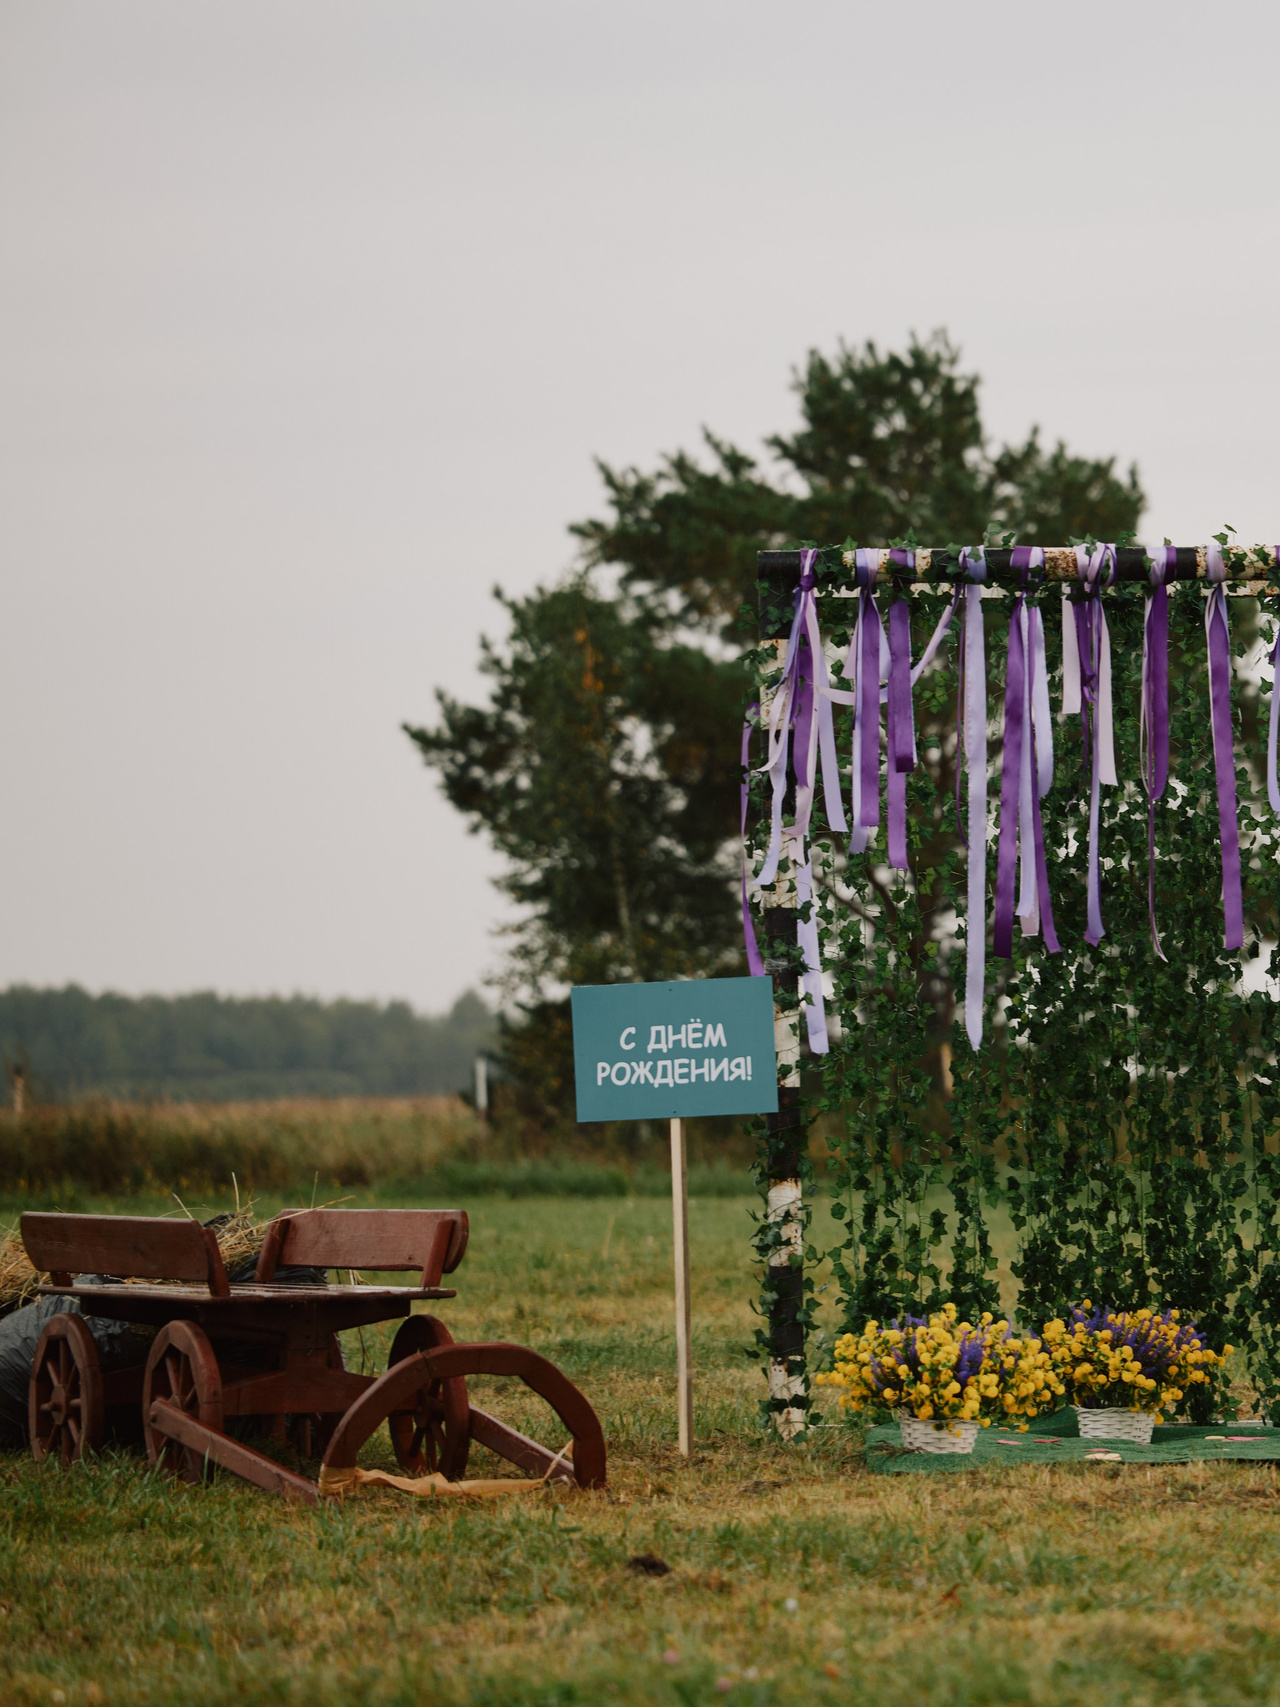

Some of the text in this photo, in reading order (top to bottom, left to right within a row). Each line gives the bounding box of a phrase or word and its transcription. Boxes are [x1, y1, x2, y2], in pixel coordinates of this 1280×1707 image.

[619, 1018, 727, 1053] С ДНЁМ
[597, 1055, 752, 1088] РОЖДЕНИЯ!
